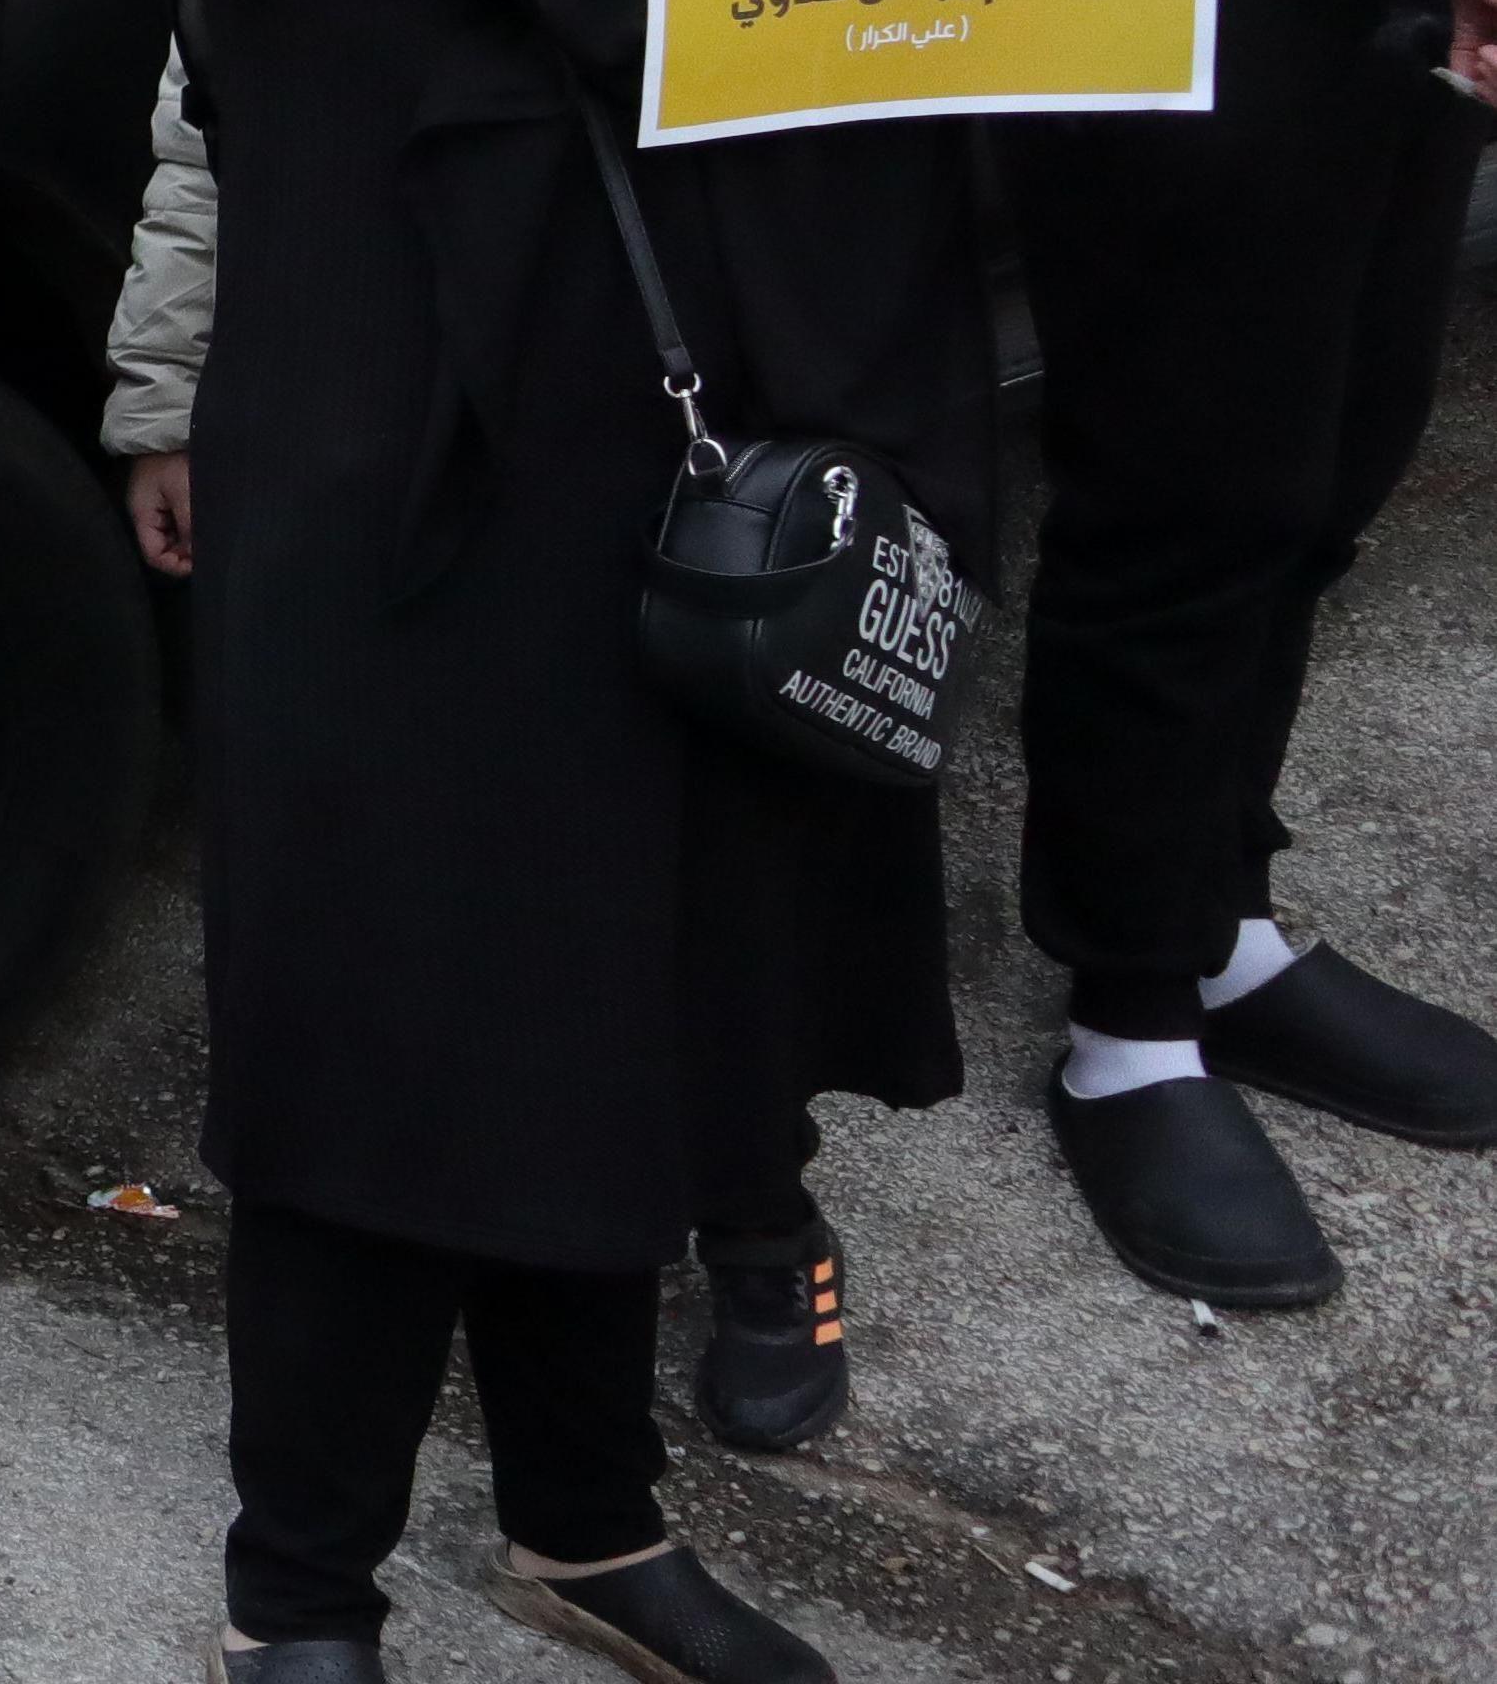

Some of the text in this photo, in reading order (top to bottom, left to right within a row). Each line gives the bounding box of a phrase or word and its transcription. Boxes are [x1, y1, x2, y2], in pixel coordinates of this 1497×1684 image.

[872, 535, 910, 584] EST
[858, 578, 957, 680] GUESS
[778, 669, 942, 770] AUTHENTIC BRAND
[842, 647, 936, 720] CALIFORNIA
